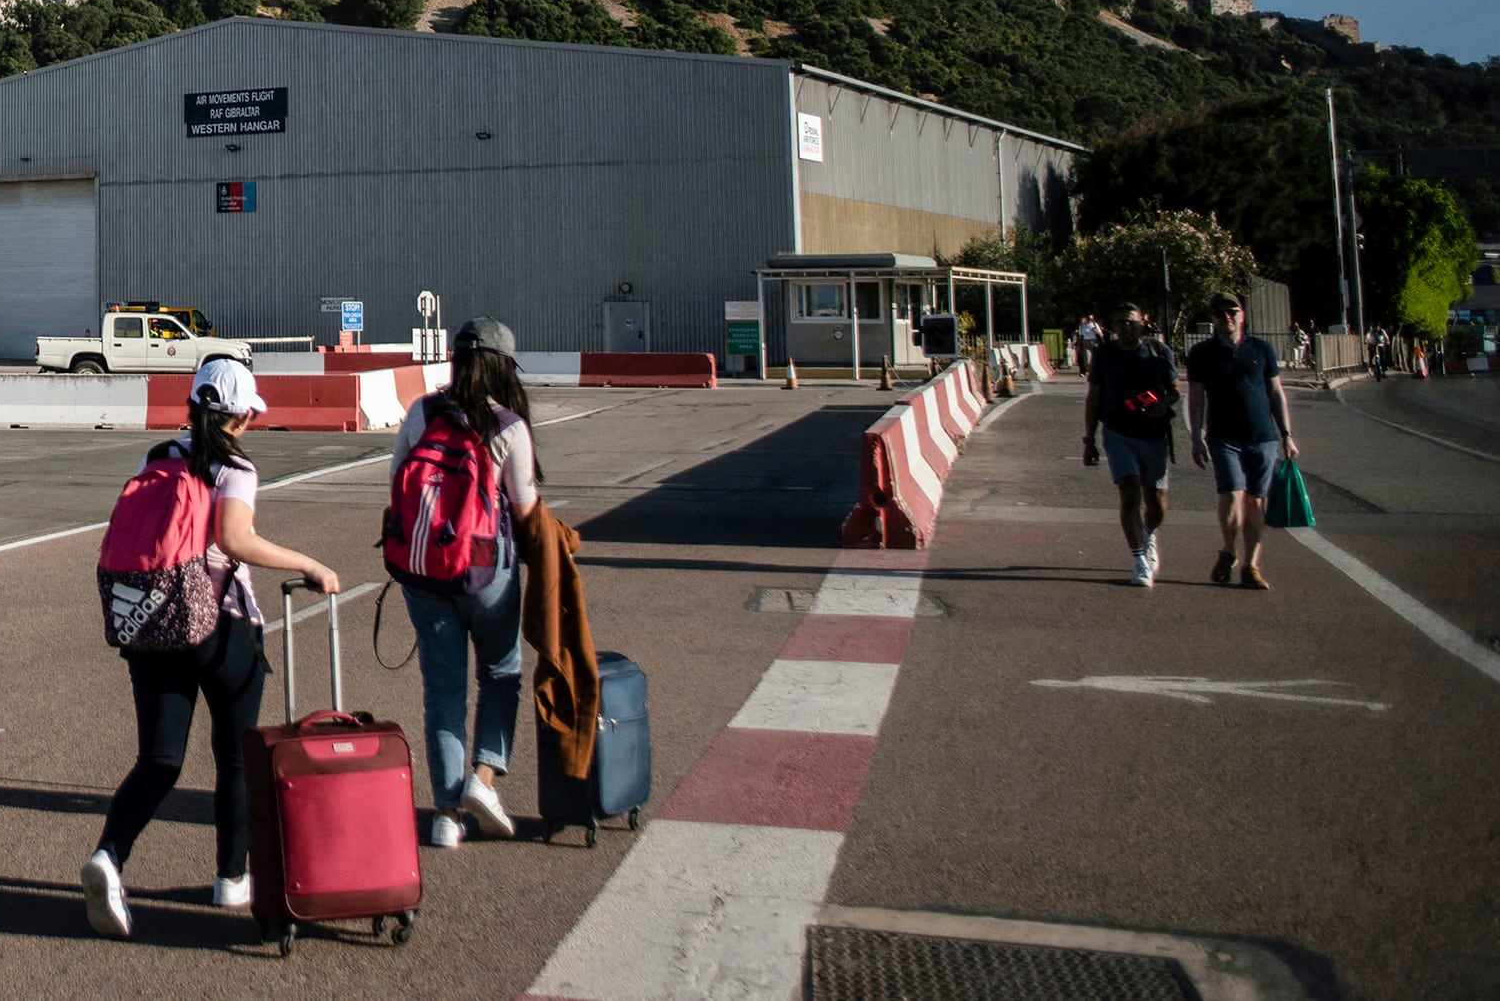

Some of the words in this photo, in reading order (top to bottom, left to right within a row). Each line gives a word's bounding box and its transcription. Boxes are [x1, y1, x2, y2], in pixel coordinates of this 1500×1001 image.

[196, 95, 207, 105] AIR
[209, 92, 250, 104] MOVEMENTS
[252, 90, 275, 101] FLIGHT
[210, 108, 223, 119] RAF
[225, 106, 260, 118] GIBRALTAR
[191, 122, 237, 134] WESTERN
[240, 119, 280, 131] HANGAR
[118, 589, 167, 644] adidas
